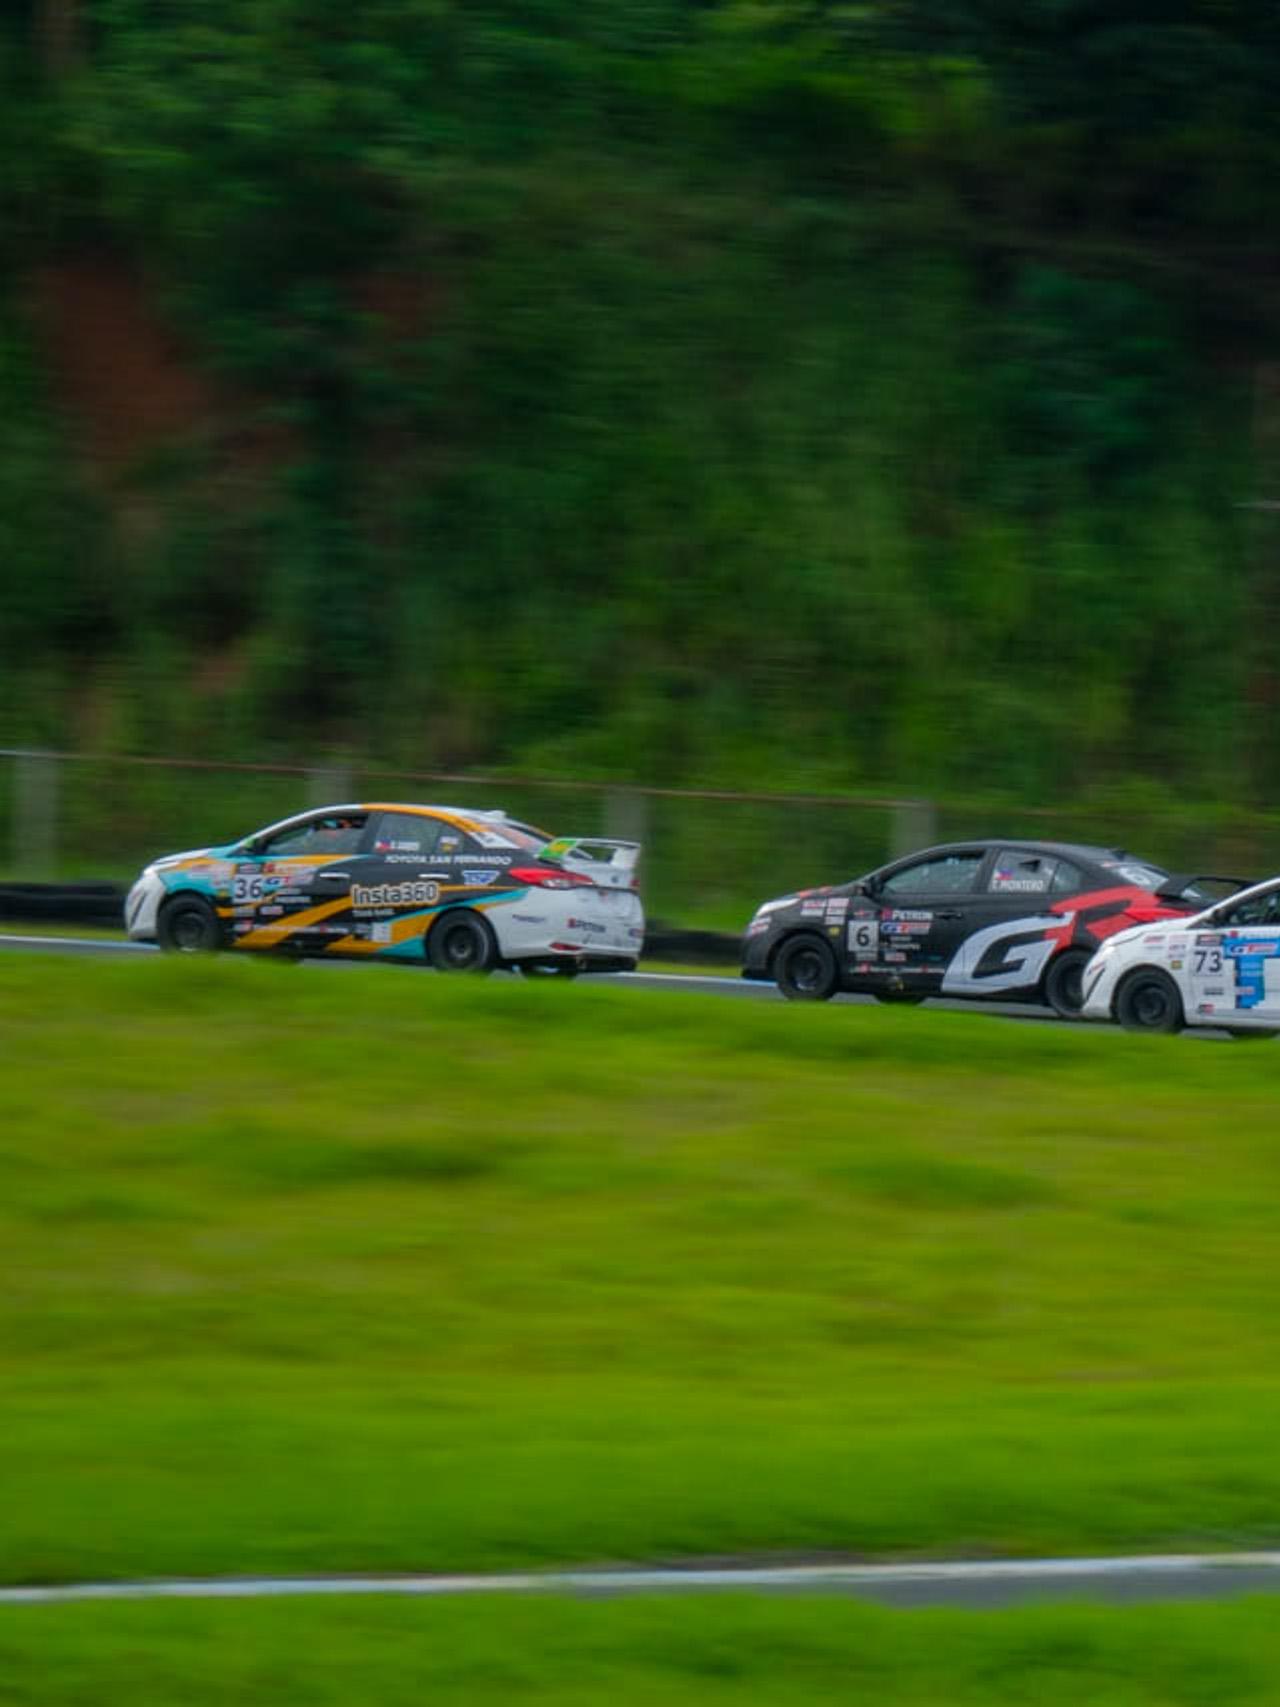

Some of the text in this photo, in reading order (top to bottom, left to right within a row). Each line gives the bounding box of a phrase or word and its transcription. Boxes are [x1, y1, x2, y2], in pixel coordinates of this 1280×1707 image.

[235, 878, 261, 899] 36
[352, 881, 440, 907] Insta360
[856, 926, 870, 947] 6
[1194, 950, 1222, 973] 73
